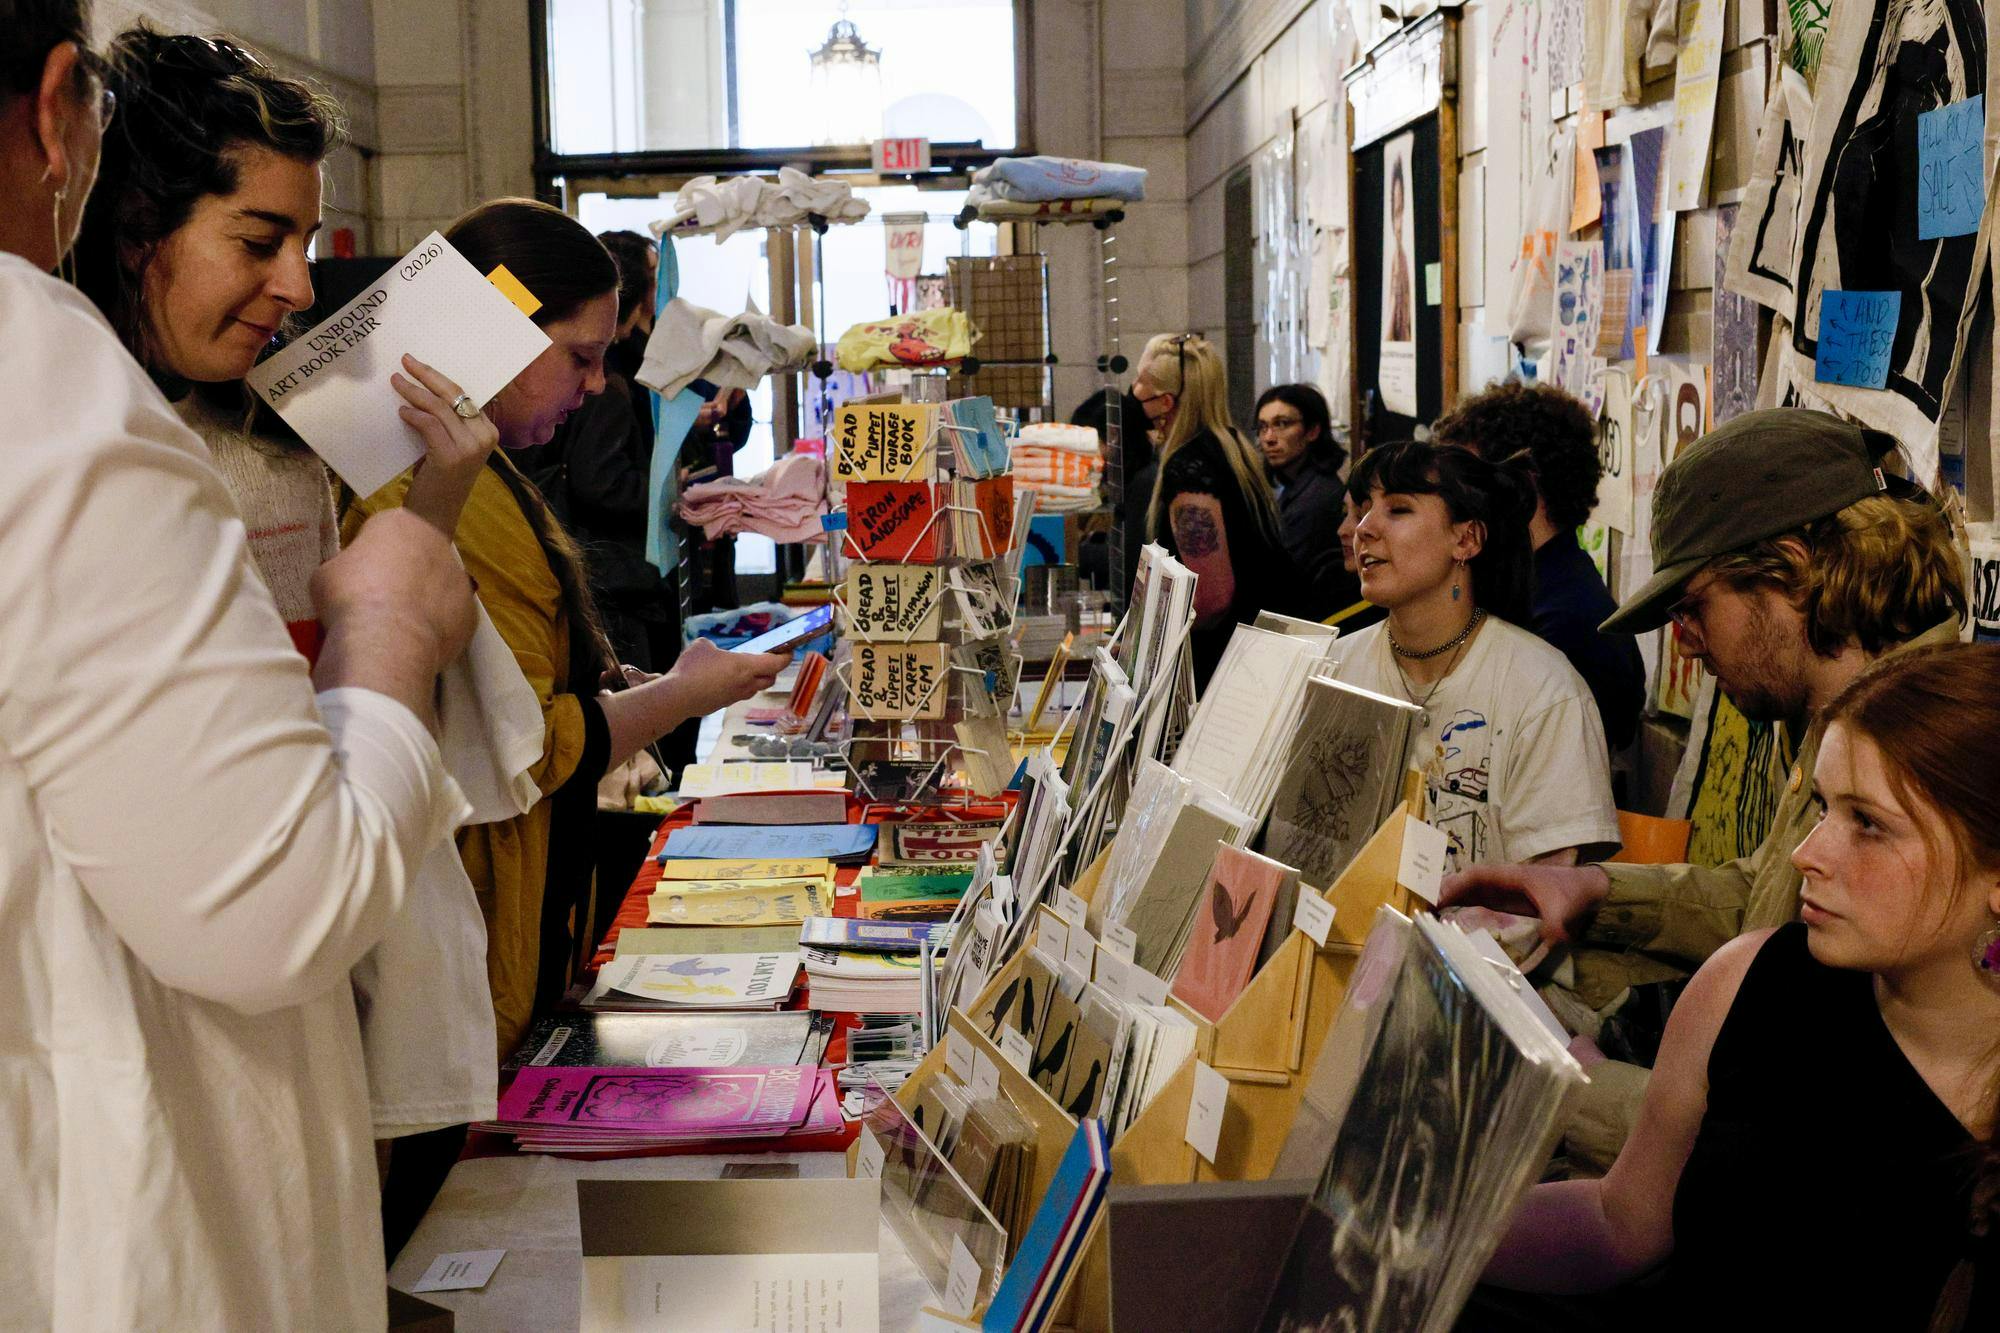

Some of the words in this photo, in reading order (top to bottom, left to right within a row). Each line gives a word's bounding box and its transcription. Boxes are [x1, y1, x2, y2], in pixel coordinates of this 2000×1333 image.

[883, 138, 922, 169] EXIT
[1923, 117, 1942, 149] ALL
[1921, 155, 1958, 219] SALE
[400, 242, 443, 282] (2026)
[306, 289, 389, 353] UNBOUND
[1854, 297, 1890, 325] AND
[267, 371, 300, 403] ART
[298, 342, 346, 379] BOOK
[344, 316, 383, 350] FAIR
[1847, 328, 1895, 358] THESE
[1851, 360, 1882, 385] TOO
[837, 413, 858, 476] BREAD
[864, 410, 881, 459] PUPPET
[885, 411, 900, 474] COURAGE
[899, 418, 916, 466] BOOK
[861, 492, 927, 551] LANDSCAPE
[853, 573, 874, 633] BREAD
[871, 606, 886, 623] &
[882, 575, 897, 633] PUPPET
[857, 647, 876, 708] BREAD
[873, 687, 889, 702] &
[886, 655, 901, 710] PUPPET
[904, 652, 918, 707] CARPE
[917, 664, 934, 713] DIEM
[745, 975, 772, 997] YOU
[752, 961, 777, 976] AM
